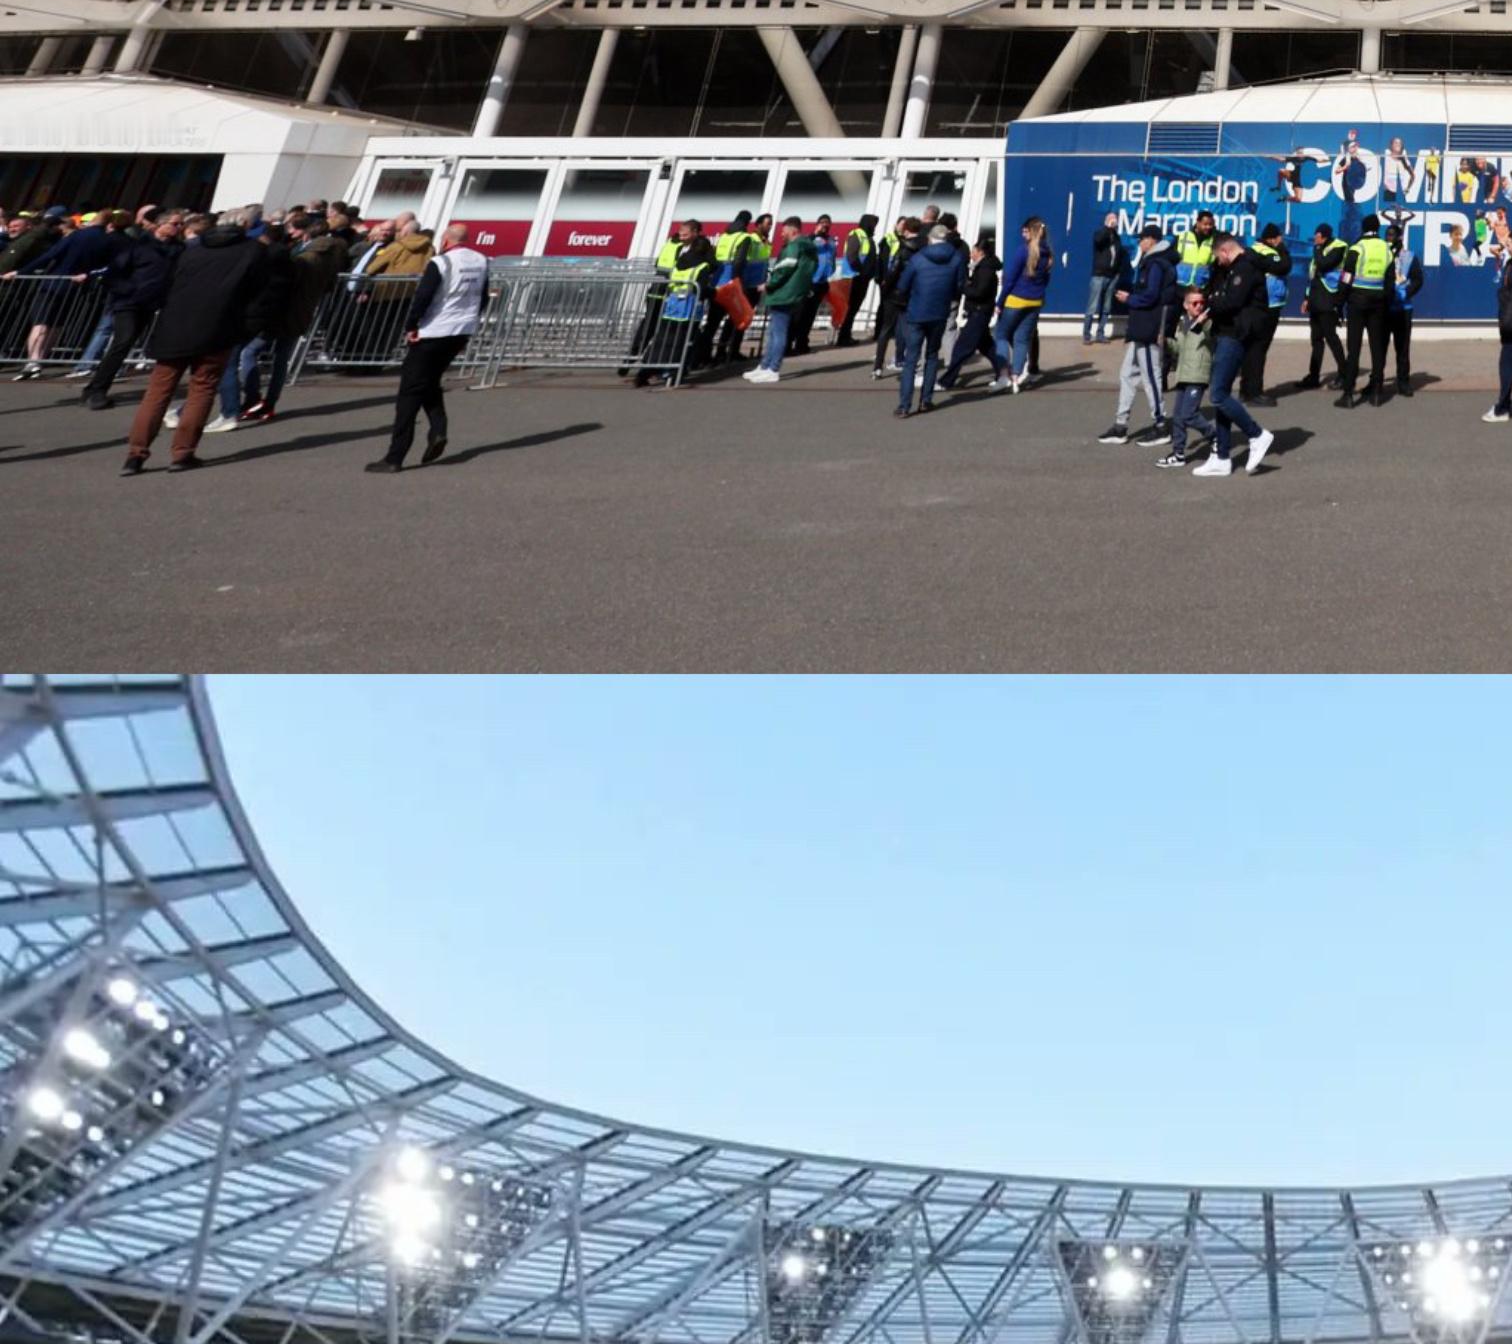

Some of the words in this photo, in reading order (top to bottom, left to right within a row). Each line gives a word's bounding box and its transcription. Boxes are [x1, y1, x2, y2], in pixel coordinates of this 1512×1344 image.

[1092, 174, 1146, 203] The
[1152, 175, 1258, 203] London
[475, 231, 497, 246] I'm
[567, 231, 612, 247] forever
